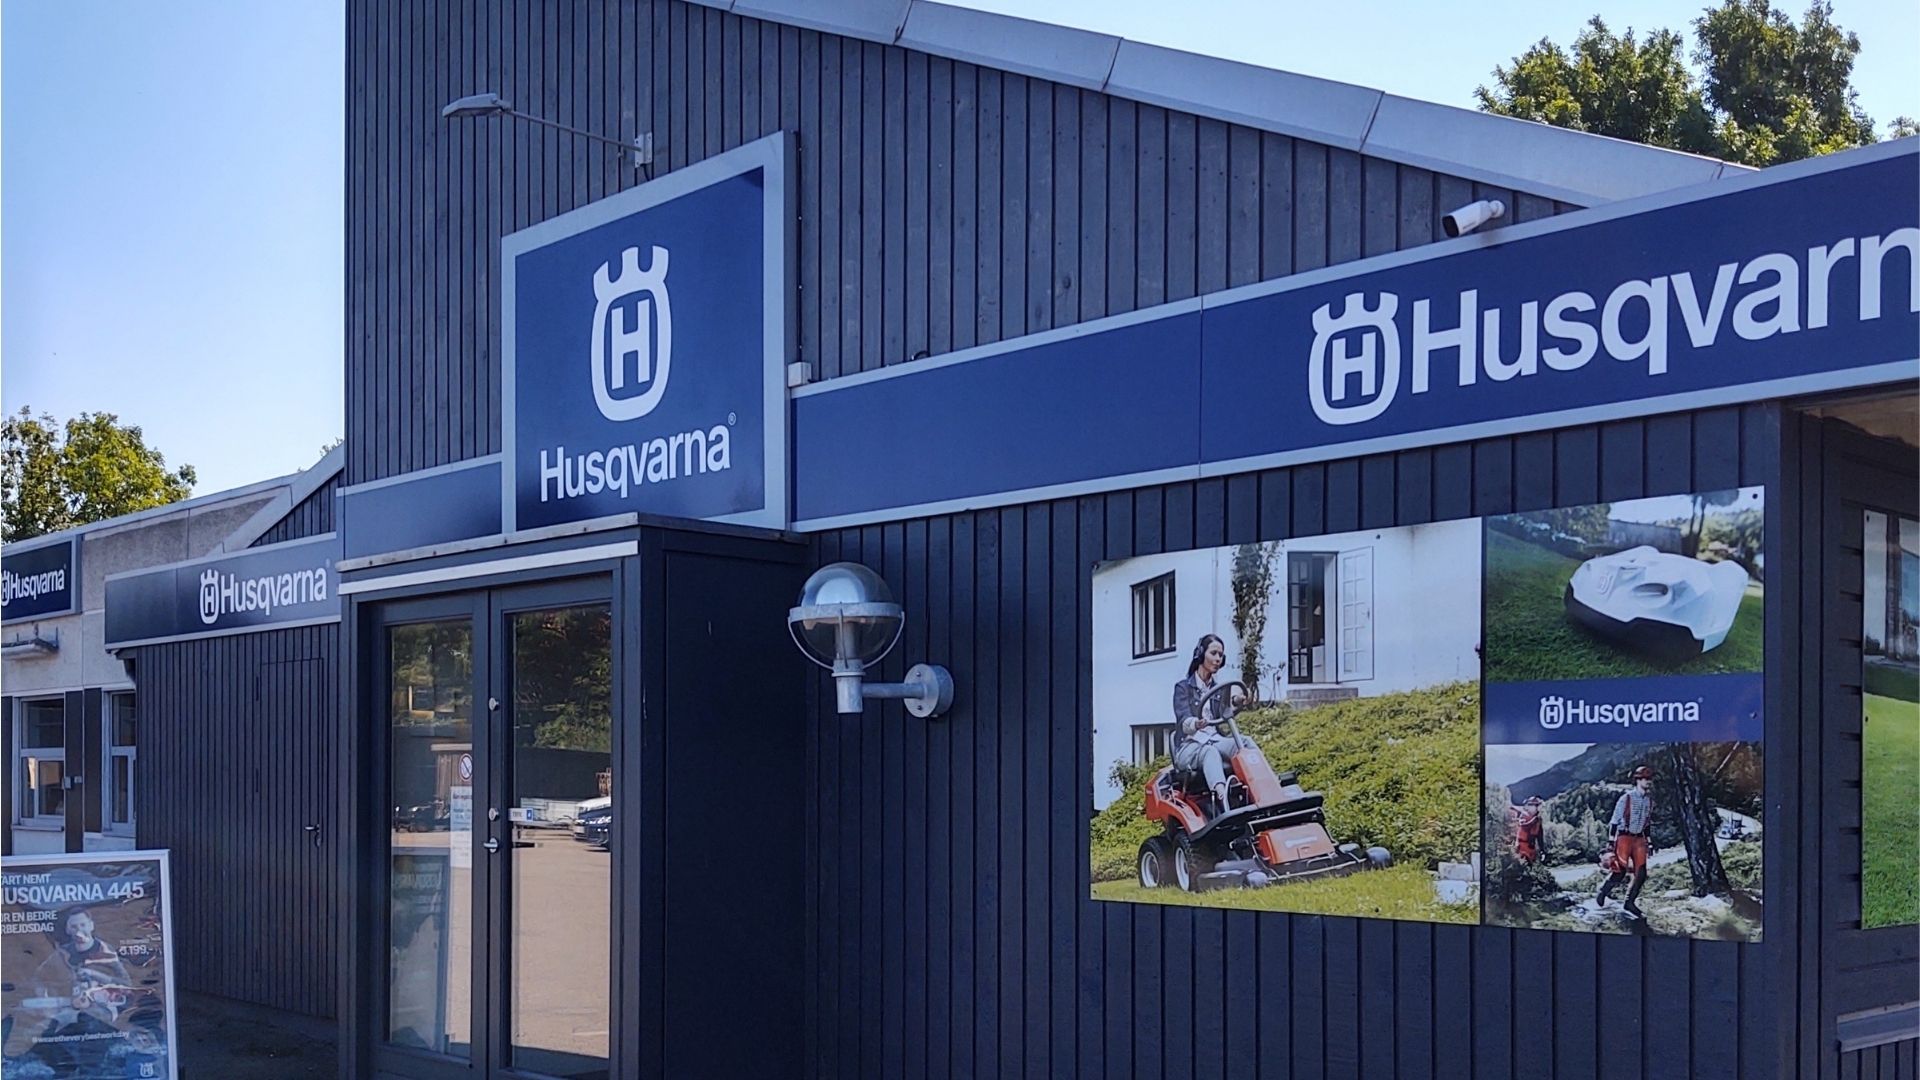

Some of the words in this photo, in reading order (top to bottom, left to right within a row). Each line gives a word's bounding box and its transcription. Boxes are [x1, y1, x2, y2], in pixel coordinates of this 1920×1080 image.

[540, 424, 731, 502] Husqvarna
[10, 569, 65, 600] Husqvarna
[220, 567, 327, 616] Husqvarna
[1566, 700, 1700, 727] Husqvarna
[1, 875, 21, 886] ART
[23, 873, 51, 884] NEMT
[107, 881, 145, 899] 445
[12, 912, 25, 922] EN
[26, 910, 58, 921] BEDRE
